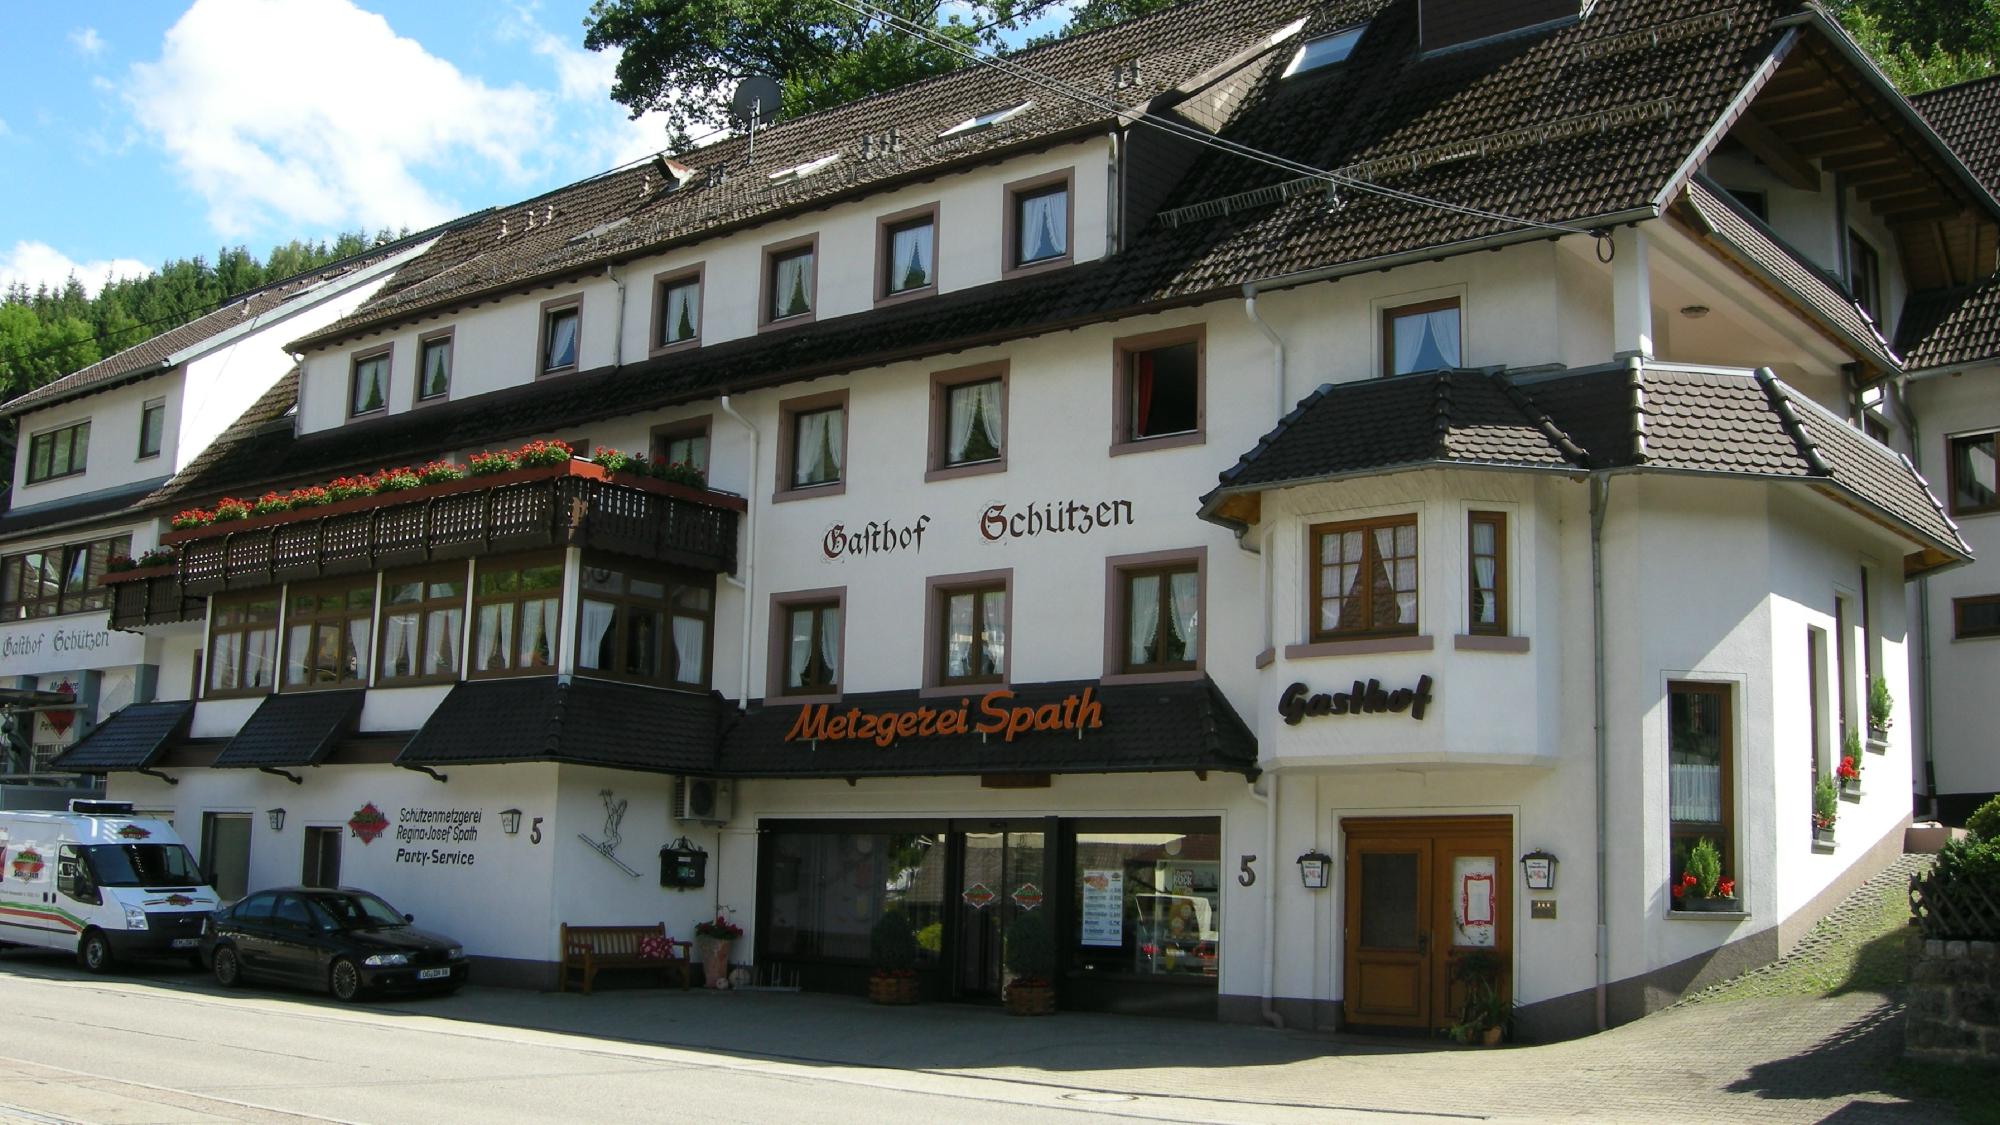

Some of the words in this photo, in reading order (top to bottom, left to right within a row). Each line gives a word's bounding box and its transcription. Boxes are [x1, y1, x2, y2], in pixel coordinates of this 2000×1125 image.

[980, 499, 1134, 542] Schützen
[54, 630, 110, 651] Schützen
[1278, 674, 1433, 726] Gasthof
[785, 698, 968, 747] Metzgerei
[975, 687, 1103, 743] Spath
[400, 807, 483, 826] Schützenmetzgerei
[530, 817, 544, 844] 5
[396, 848, 475, 866] Party-Service
[1238, 855, 1256, 887] 5
